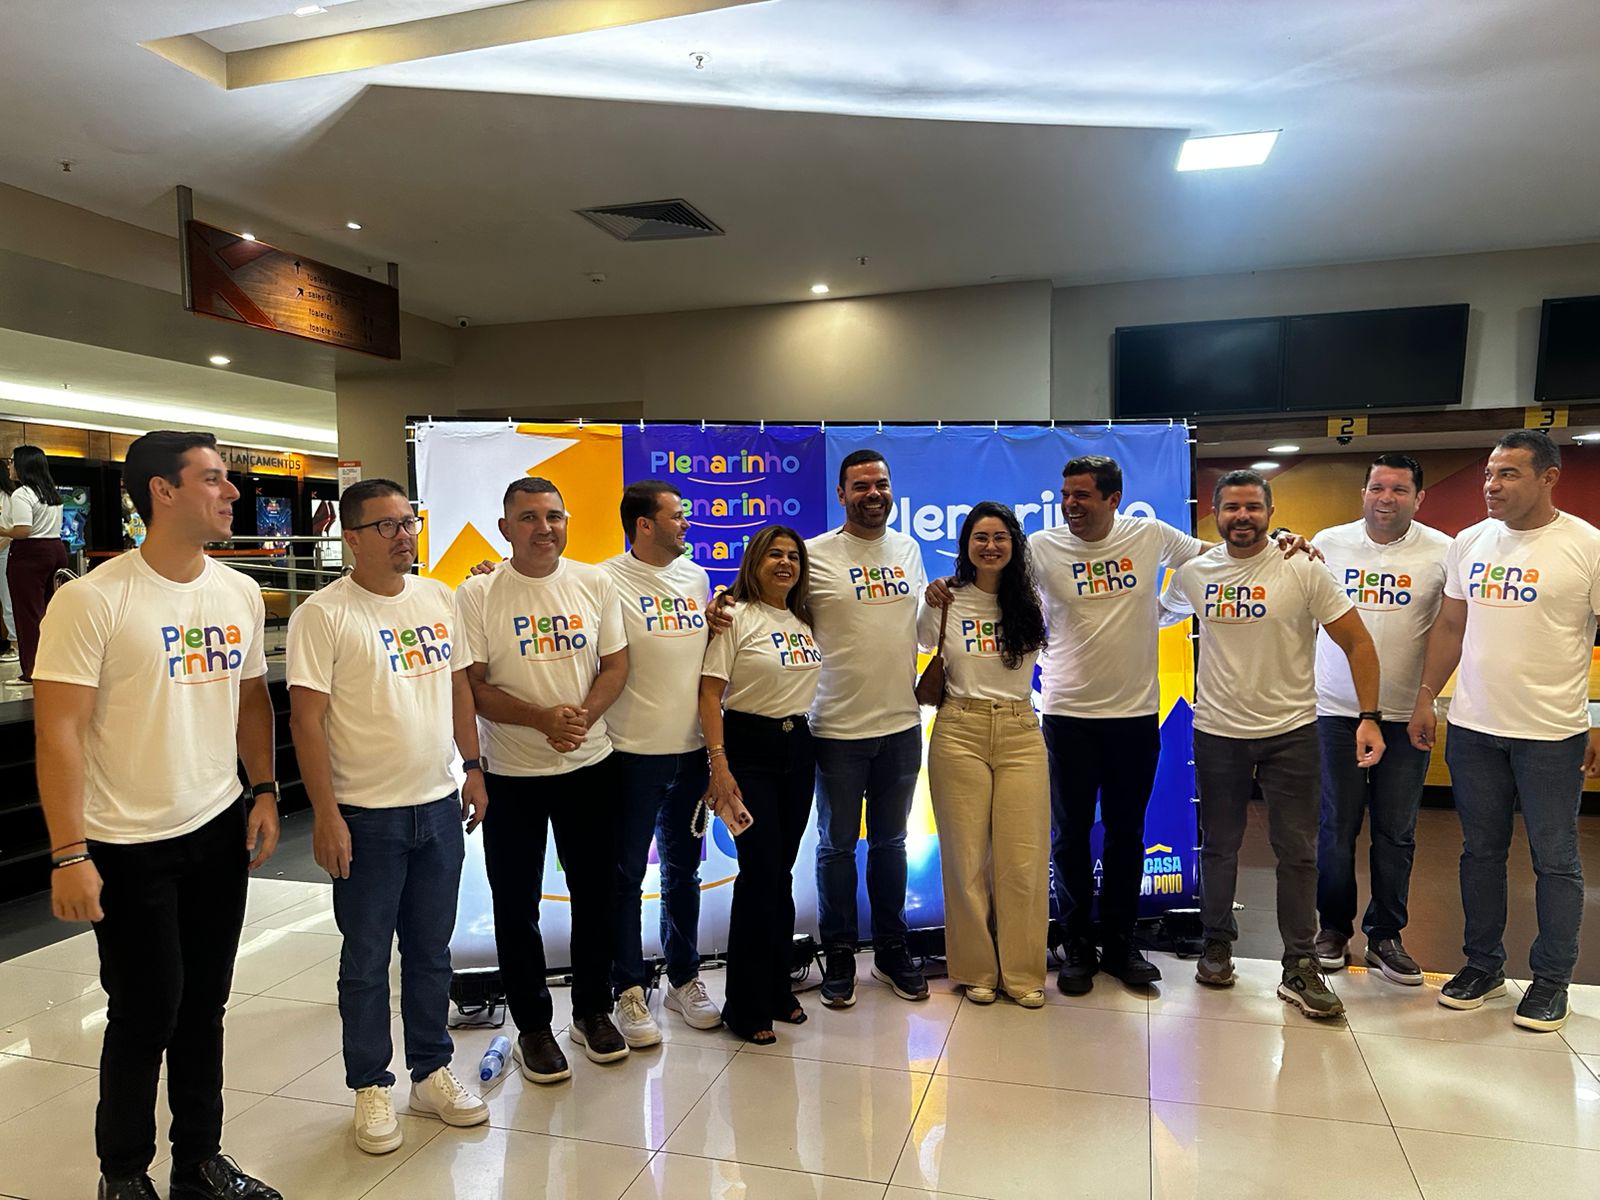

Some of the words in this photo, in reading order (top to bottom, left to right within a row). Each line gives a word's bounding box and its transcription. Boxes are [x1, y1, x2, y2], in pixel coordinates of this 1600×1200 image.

[1341, 417, 1355, 435] 2
[1540, 408, 1554, 426] 3
[651, 449, 800, 474] Plenarinho
[681, 492, 801, 517] enarinho
[684, 535, 750, 560] enari
[849, 566, 906, 584] Plena
[1072, 557, 1133, 579] Plena
[1345, 568, 1412, 589] Plena
[1469, 562, 1540, 584] Plena
[856, 580, 910, 601] rinho
[1077, 574, 1137, 596] rinho
[1205, 583, 1266, 601] Plena
[1346, 584, 1412, 606] rinho
[1469, 578, 1538, 603] rinho
[640, 595, 699, 613] Plena
[1205, 600, 1267, 618] rinho
[513, 614, 584, 637] Plena
[646, 612, 704, 632] rinho
[962, 619, 1004, 636] Plen
[161, 624, 241, 652] Plena
[379, 622, 449, 651] Plena
[520, 632, 587, 657] rinho
[771, 631, 814, 649] Plena
[966, 634, 1003, 652] rinh
[168, 647, 242, 677] rinho
[390, 643, 451, 672] rinho
[780, 646, 822, 666] rinho
[1144, 856, 1182, 874] CASA
[1154, 873, 1183, 895] POVO
